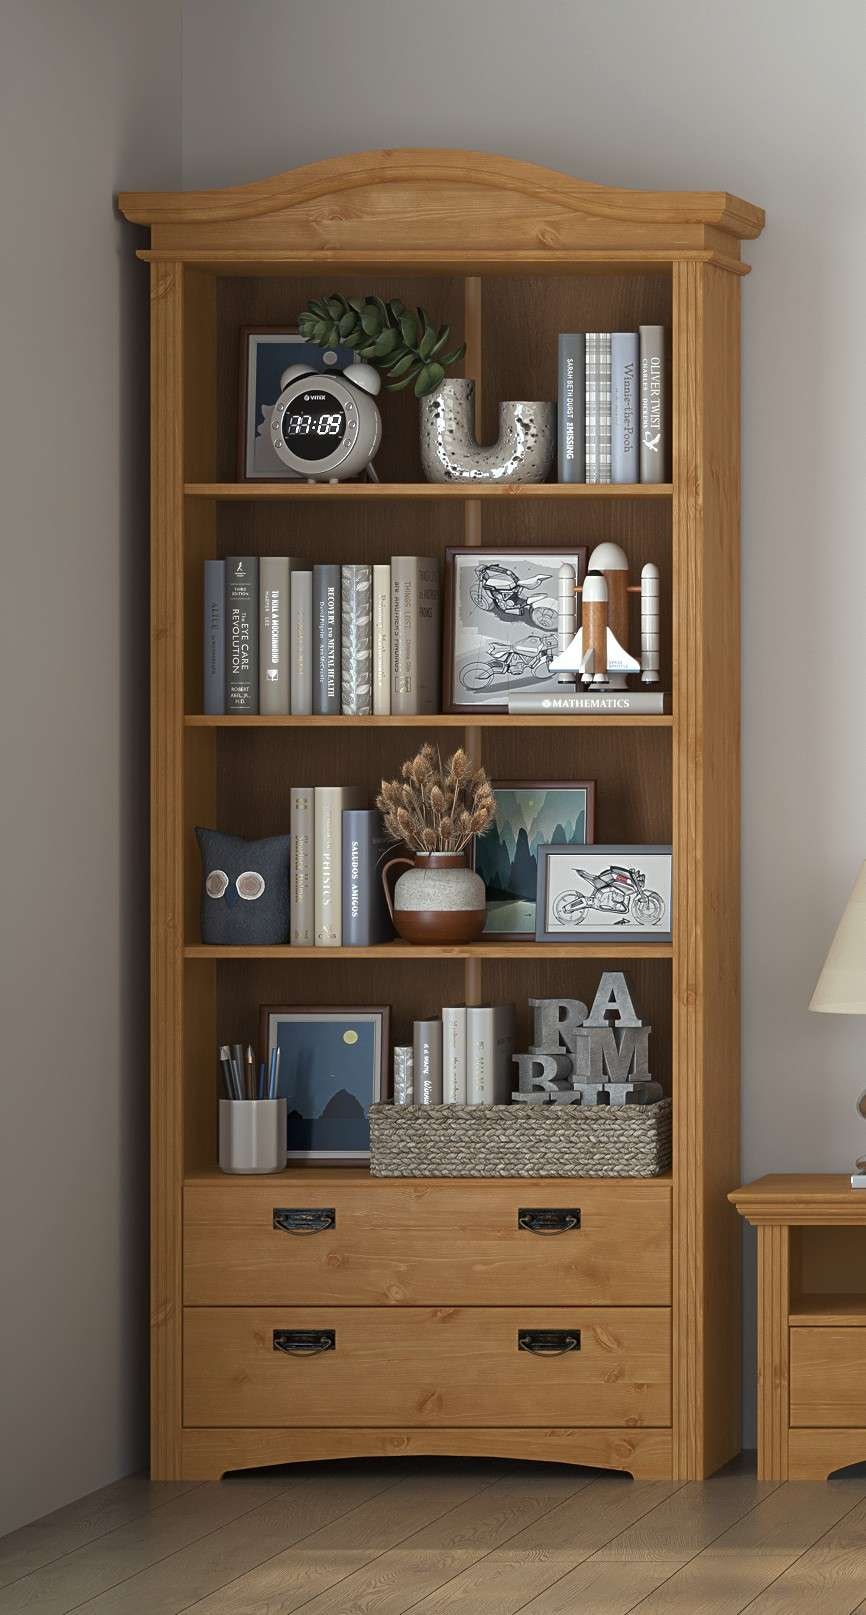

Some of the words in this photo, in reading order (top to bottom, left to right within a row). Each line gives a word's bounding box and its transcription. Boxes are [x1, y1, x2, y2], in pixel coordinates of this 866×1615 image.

[650, 357, 661, 396] OLIVER
[623, 362, 635, 454] Winnie-the-Pooh
[650, 399, 661, 430] TWIST
[271, 599, 279, 612] KILL
[327, 587, 335, 625] RECOVERY
[232, 608, 241, 674] REVOLUTION
[241, 623, 249, 641] EYE
[241, 643, 249, 671] CARE
[327, 638, 335, 668] MENTAL
[327, 669, 335, 697] HEALTH
[552, 699, 631, 708] MATHEMATICS
[351, 841, 359, 880] SALUDOS
[351, 884, 359, 919] AMIGOS
[583, 972, 643, 1027] A
[528, 998, 589, 1055] R
[573, 1026, 653, 1083] M
